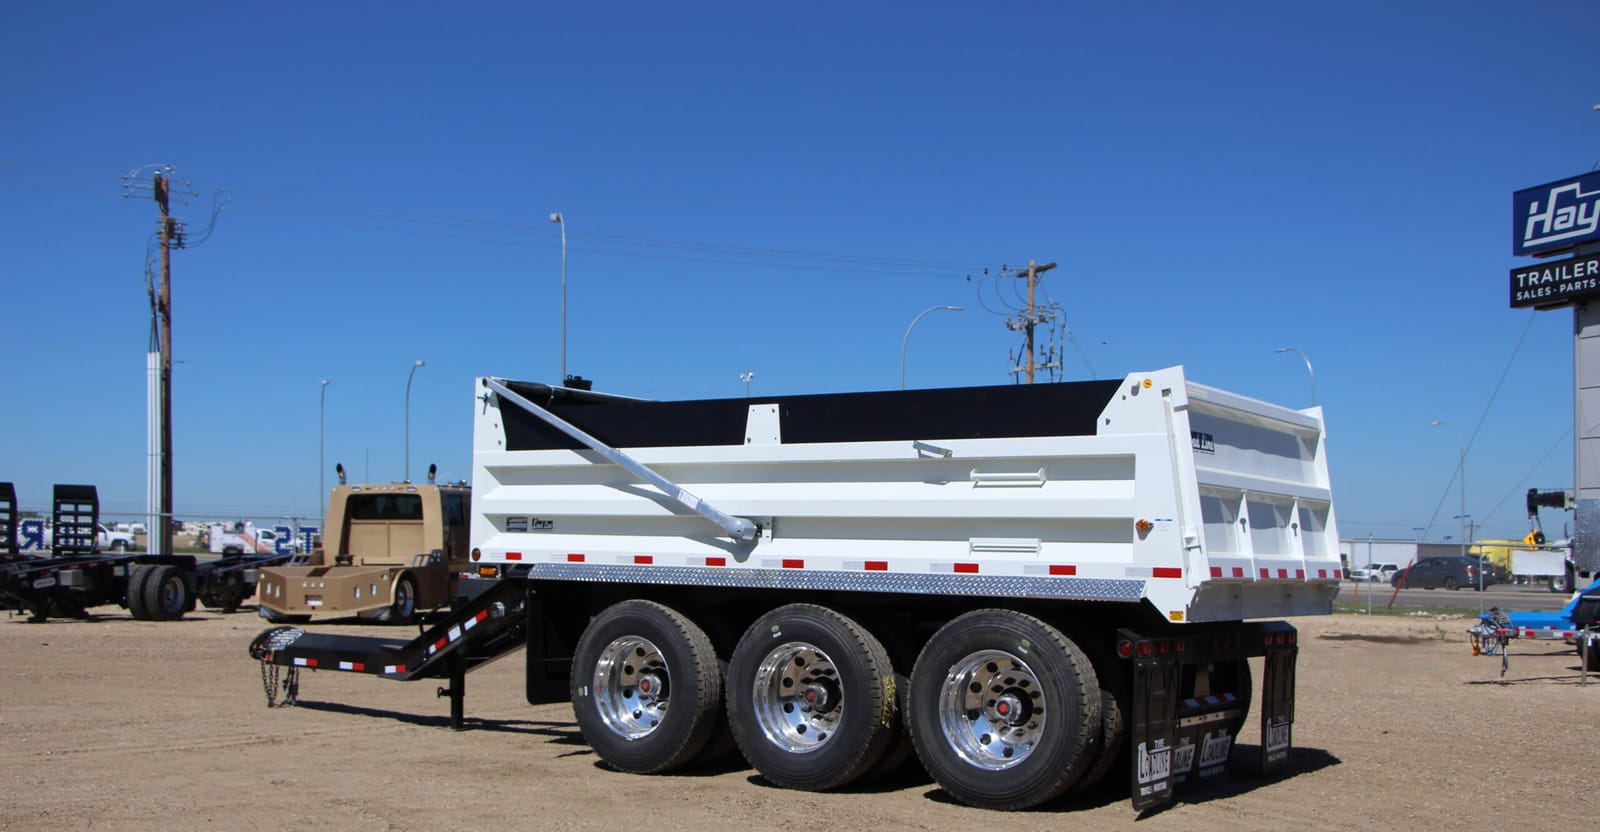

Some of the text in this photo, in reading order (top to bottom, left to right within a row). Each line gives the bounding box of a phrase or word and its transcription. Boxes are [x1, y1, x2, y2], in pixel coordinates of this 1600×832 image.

[1516, 260, 1598, 288] TRAILER
[1516, 278, 1596, 301] SALES PARTS
